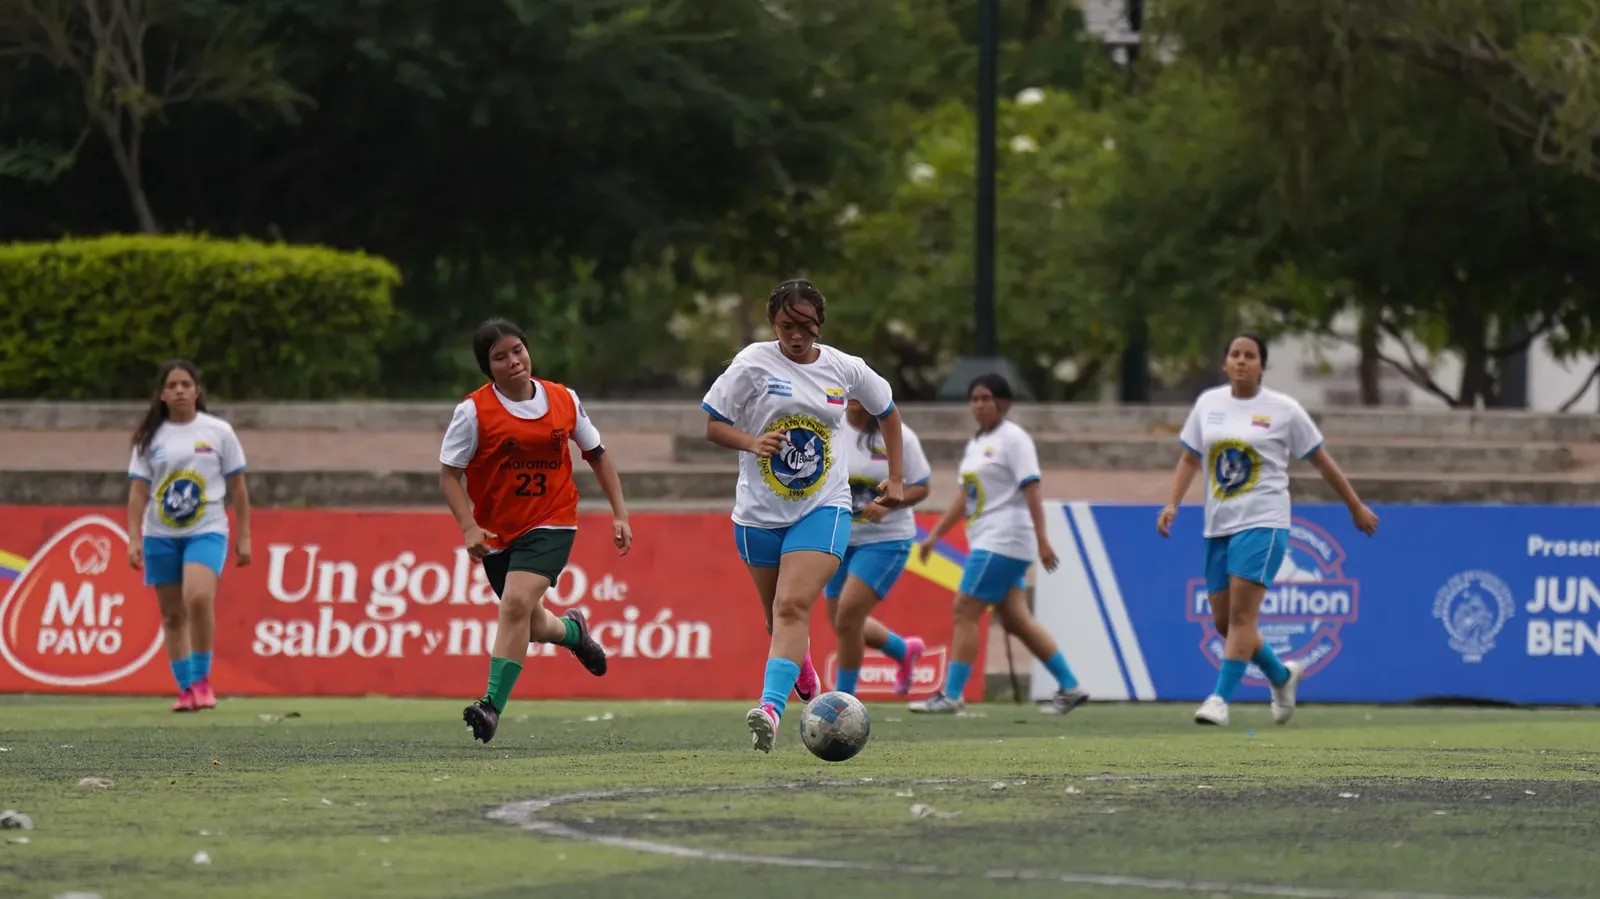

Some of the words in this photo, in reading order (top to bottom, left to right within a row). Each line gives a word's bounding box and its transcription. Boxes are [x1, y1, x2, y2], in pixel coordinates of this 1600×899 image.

[515, 472, 547, 497] 23
[789, 489, 805, 497] 1989
[267, 544, 358, 603] Un
[365, 547, 588, 621] golao
[592, 573, 629, 601] de
[41, 580, 125, 627] Mr.
[1195, 587, 1350, 615] athon
[36, 627, 122, 655] PAVO
[252, 605, 422, 658] sabor
[422, 629, 444, 656] y
[445, 604, 712, 660] nción
[1526, 619, 1600, 657] BEN
